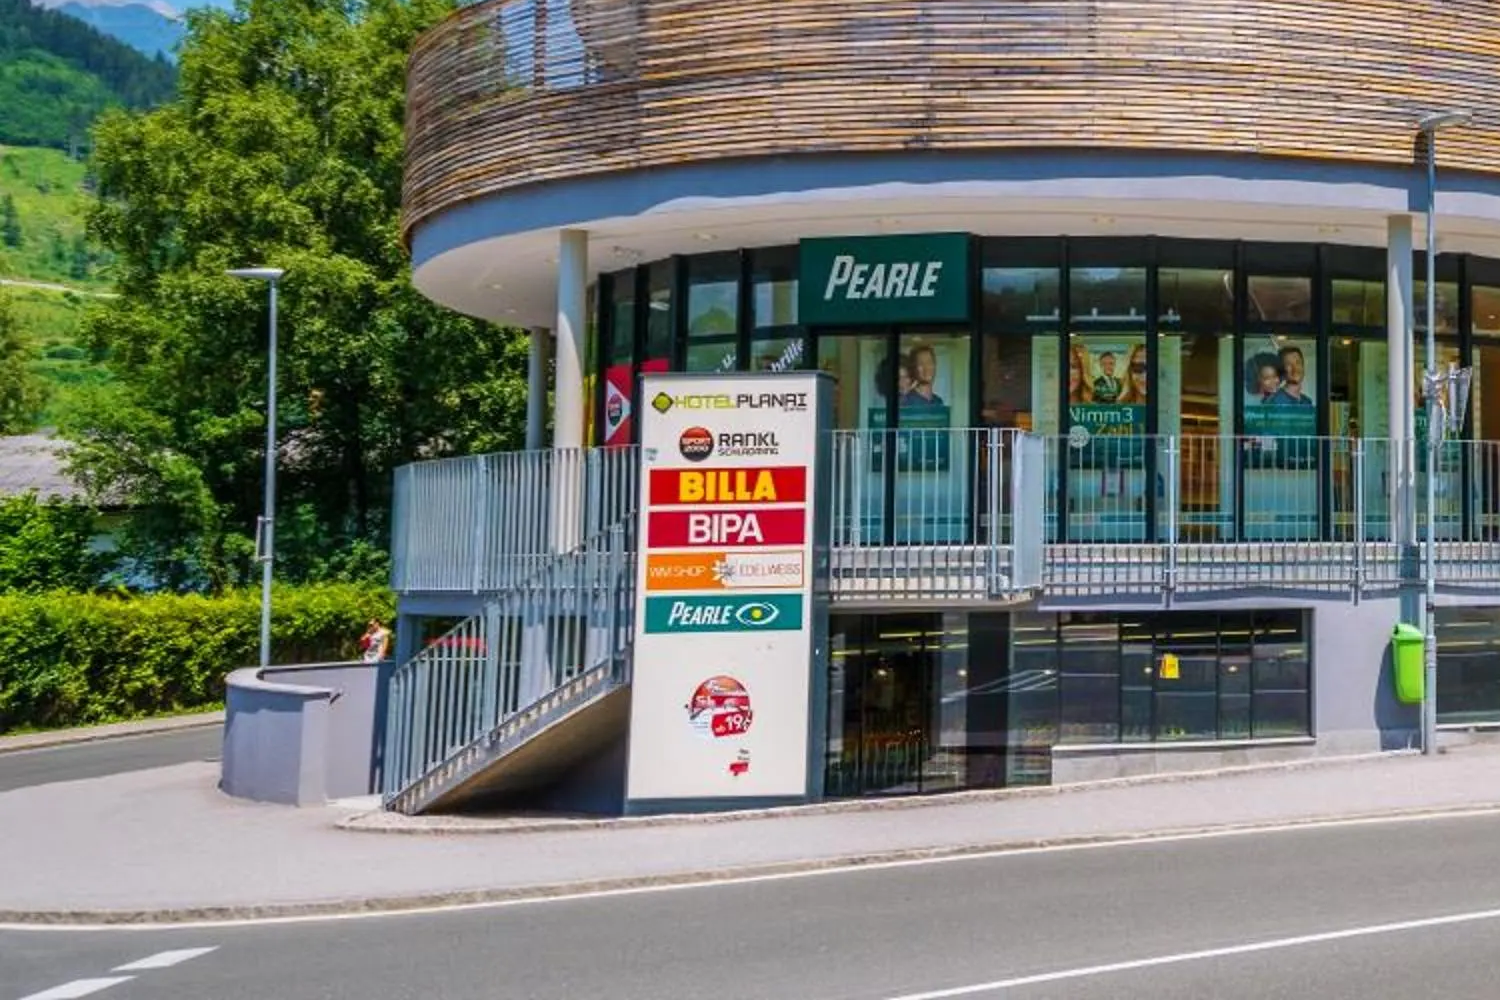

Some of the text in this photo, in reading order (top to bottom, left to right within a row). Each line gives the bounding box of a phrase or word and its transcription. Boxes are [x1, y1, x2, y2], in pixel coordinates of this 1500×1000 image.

[823, 254, 943, 301] PEARLE
[718, 431, 780, 447] RANKL
[679, 470, 777, 502] BILLA
[688, 512, 764, 544] BIPA
[738, 562, 801, 577] EDELWEISS
[668, 600, 733, 626] PEARLE
